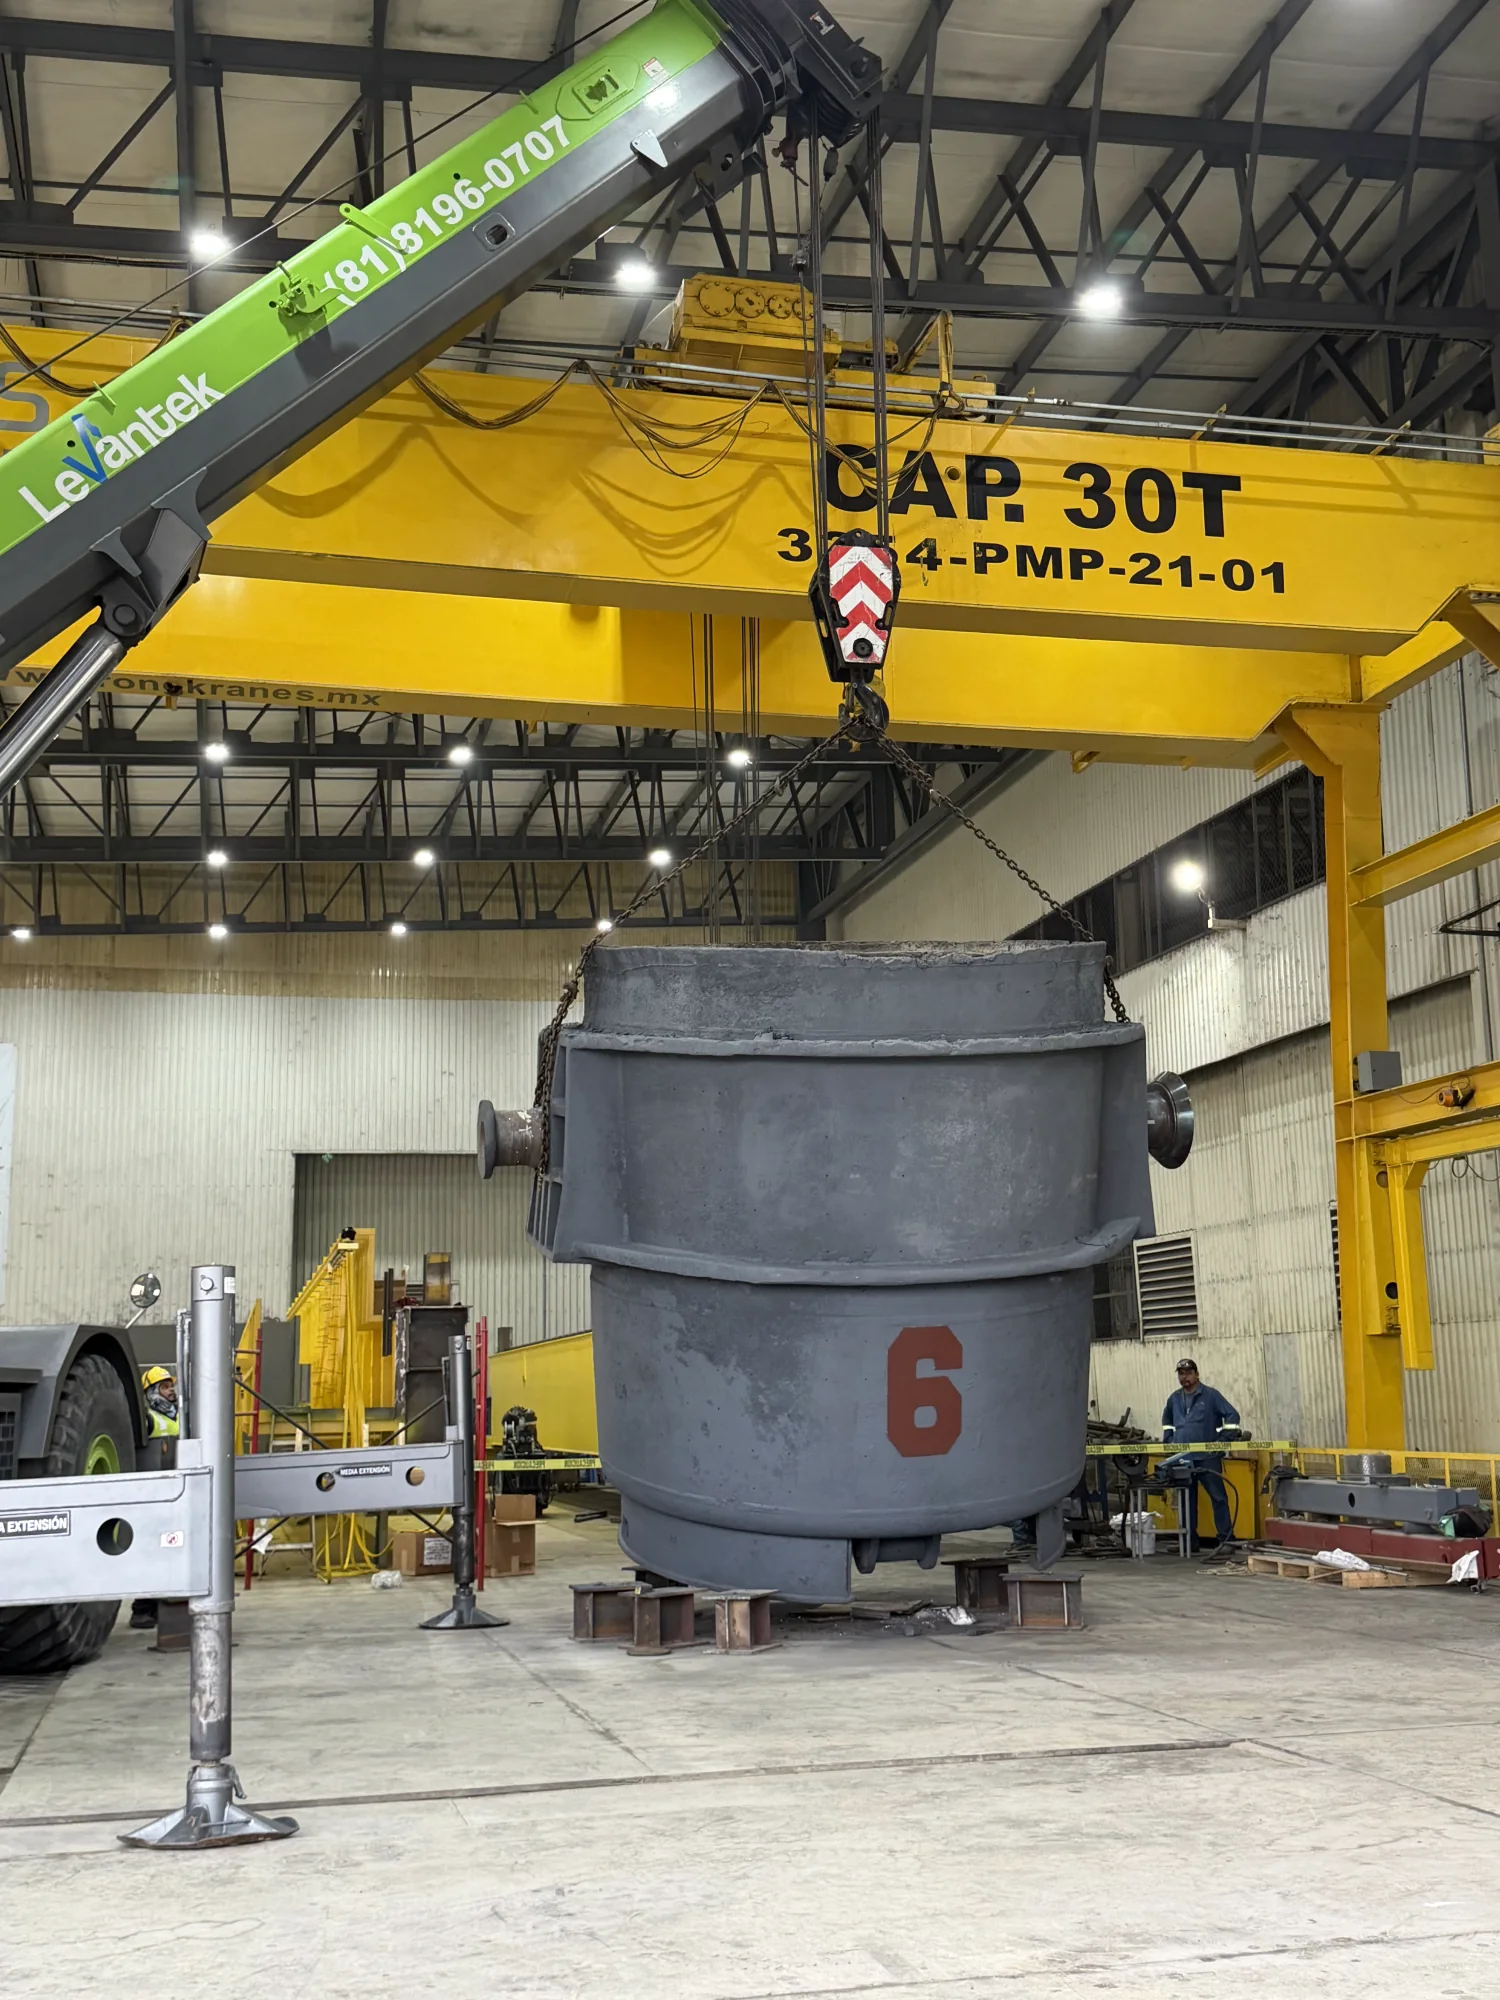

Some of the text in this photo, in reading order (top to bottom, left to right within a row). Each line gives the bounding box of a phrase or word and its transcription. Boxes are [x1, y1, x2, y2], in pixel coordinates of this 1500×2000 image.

[319, 114, 571, 307] (81)8196-0707
[18, 372, 226, 523] LeVantek
[825, 443, 1242, 538] CAP. 30T
[777, 527, 1286, 594] 34-PMP-21-01
[887, 1325, 963, 1458] 6
[340, 1468, 358, 1476] MEDIA
[7, 1514, 67, 1533] EXTENSIÓN
